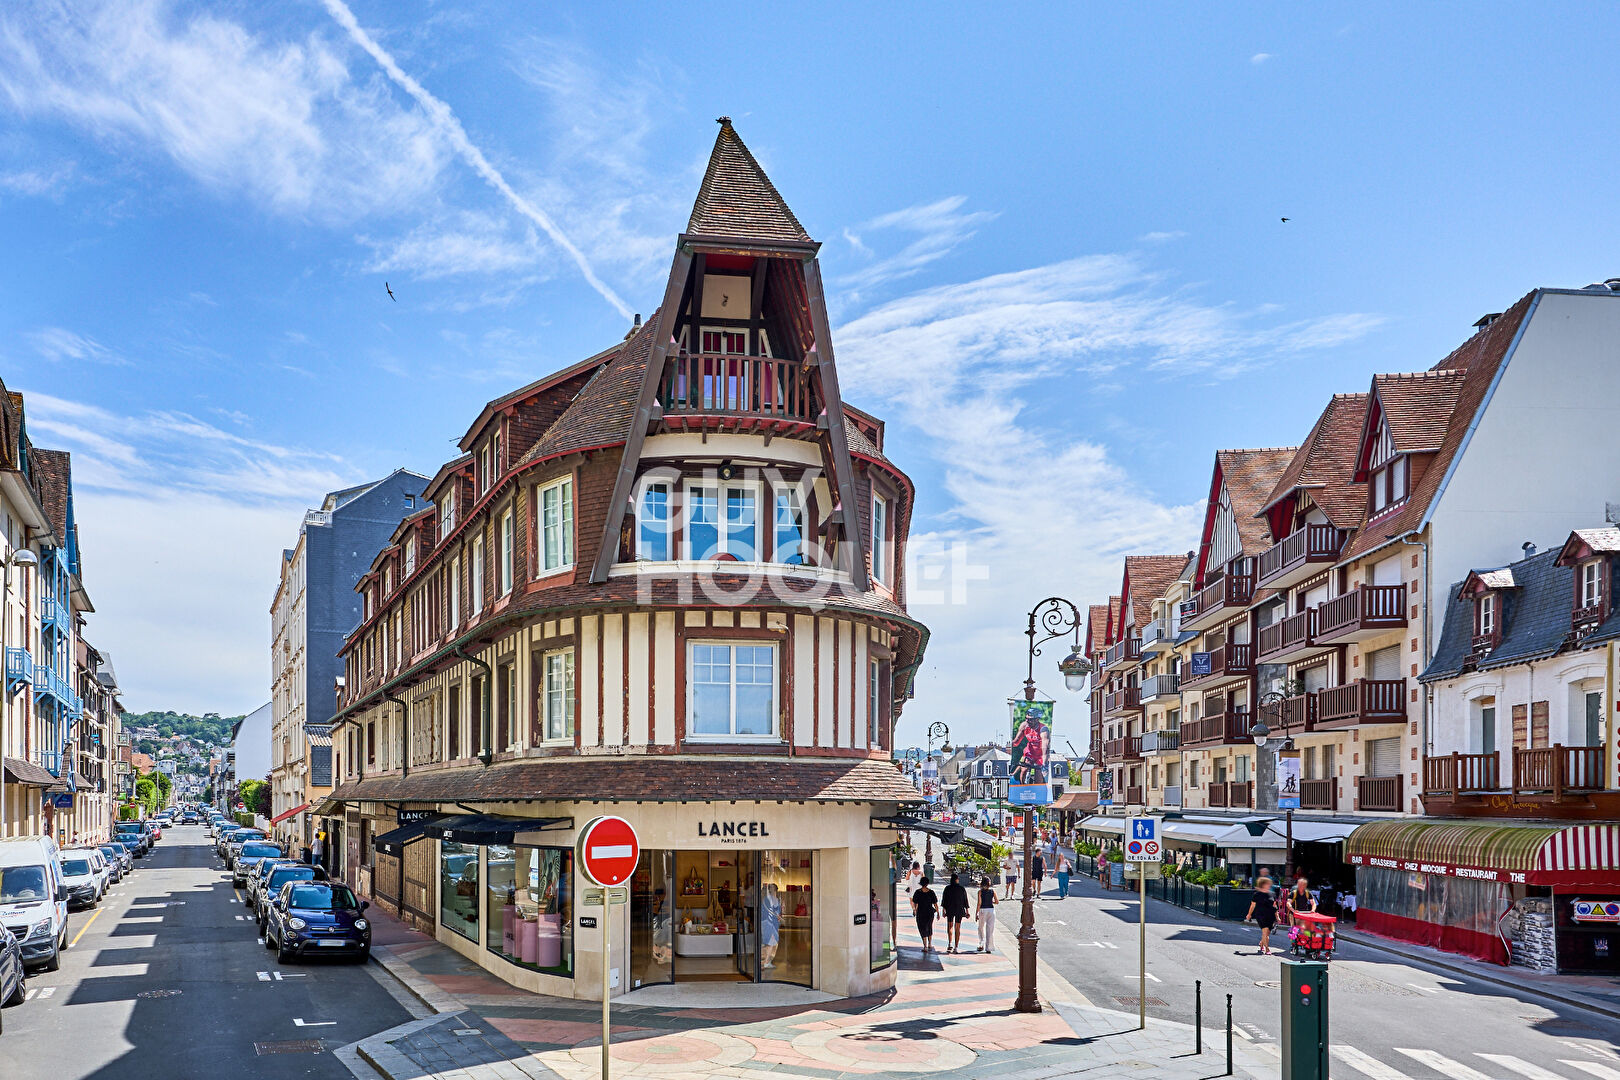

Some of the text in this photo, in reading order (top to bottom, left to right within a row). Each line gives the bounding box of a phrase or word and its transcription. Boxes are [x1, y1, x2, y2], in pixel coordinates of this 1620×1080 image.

[400, 812, 432, 820] LANCE
[698, 822, 769, 836] LANCEL
[1351, 856, 1525, 883] BAR BRASSERIE CHEZ MIOCQUE RESTAURANT THE
